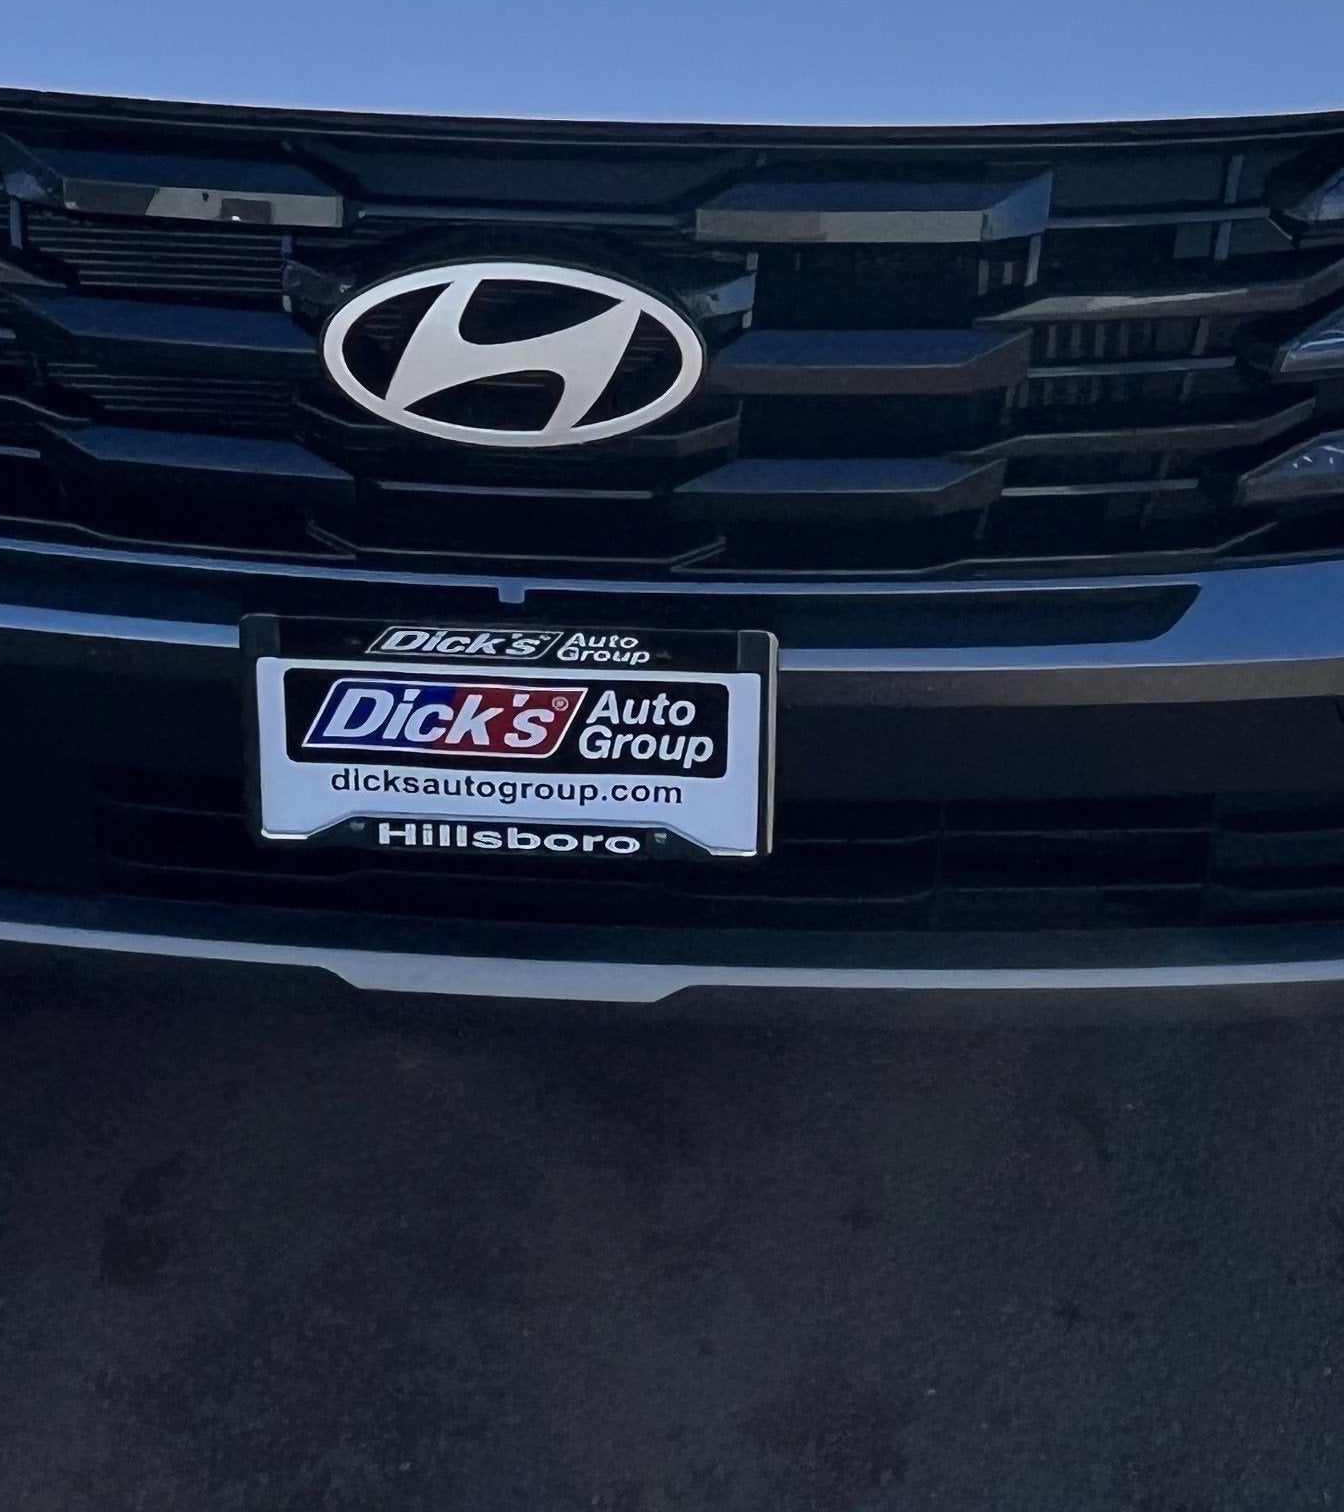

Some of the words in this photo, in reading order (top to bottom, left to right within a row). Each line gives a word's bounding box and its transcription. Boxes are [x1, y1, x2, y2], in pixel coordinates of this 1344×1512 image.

[380, 629, 541, 656] Dick's
[566, 632, 639, 648] Auto
[556, 646, 650, 666] Group
[323, 687, 555, 750] Dick's
[586, 691, 696, 727] Auto
[578, 724, 714, 769] Group
[331, 769, 683, 805] dicksautogroup.com
[378, 822, 641, 855] Hillsboro
